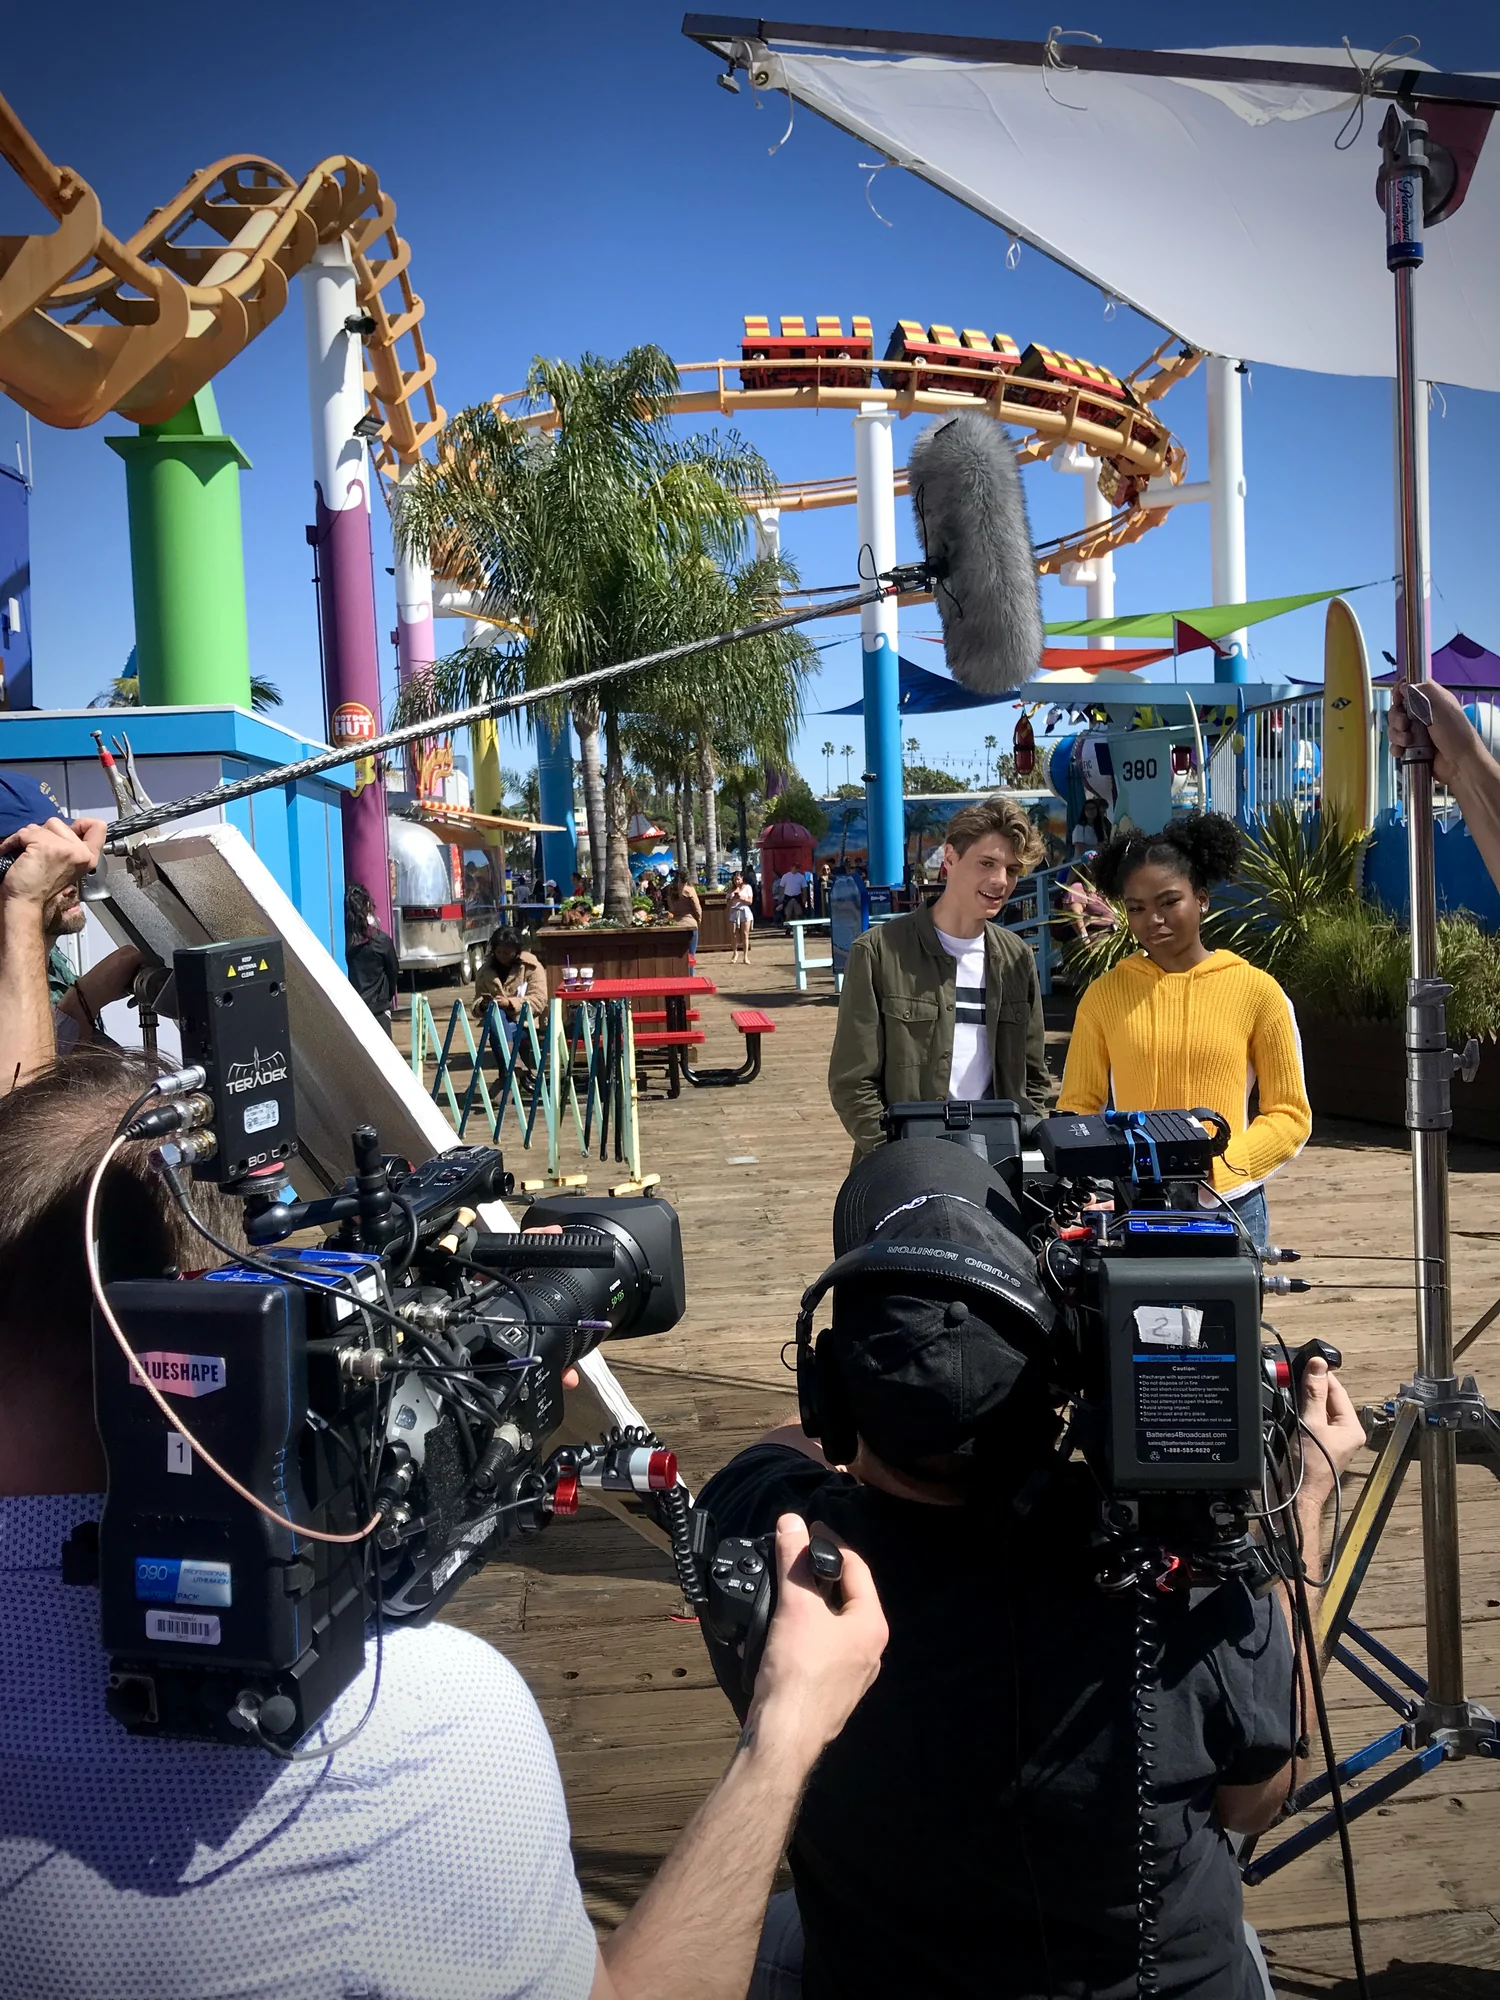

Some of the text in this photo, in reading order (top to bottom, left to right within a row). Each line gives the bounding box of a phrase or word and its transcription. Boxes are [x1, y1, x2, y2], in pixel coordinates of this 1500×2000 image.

[1397, 181, 1414, 242] Paramount
[334, 722, 372, 736] HUT
[1122, 758, 1157, 782] 380
[238, 963, 257, 971] ANTENNA
[226, 1066, 288, 1096] TERADEK
[887, 1246, 1022, 1288] STUDIO MONITOR
[1152, 1317, 1171, 1337] 2
[176, 1442, 183, 1463] 1
[138, 1564, 167, 1580] 090
[178, 1592, 200, 1600] PACK
